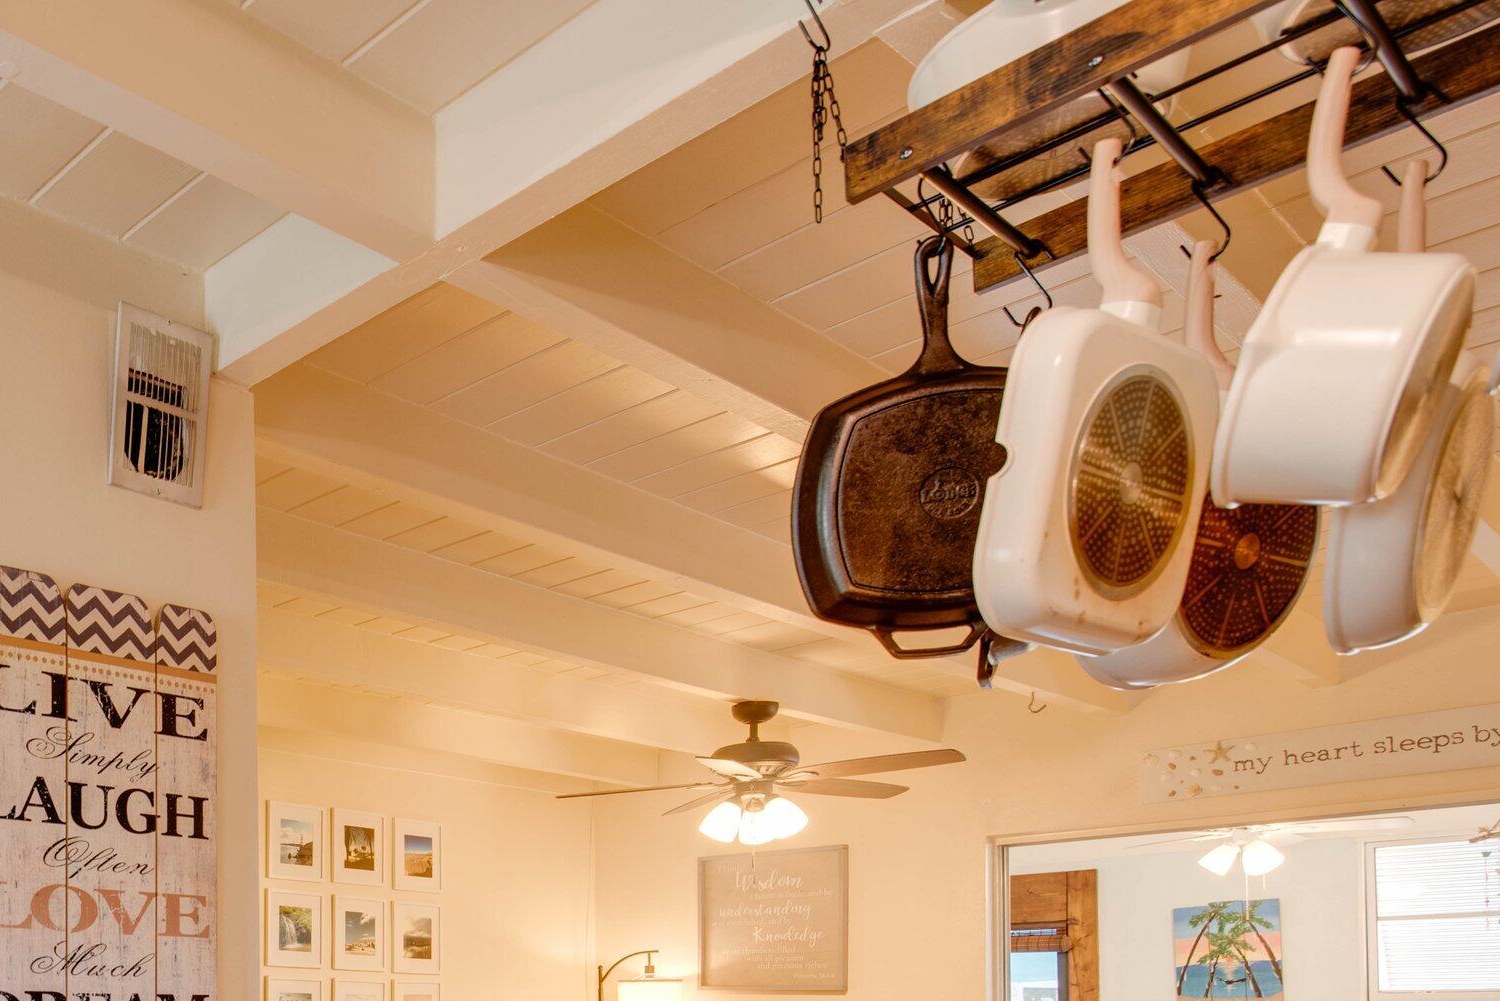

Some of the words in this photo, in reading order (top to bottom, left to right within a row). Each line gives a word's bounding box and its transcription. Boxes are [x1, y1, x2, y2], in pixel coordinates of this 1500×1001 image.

[26, 726, 160, 783] Simply
[1234, 753, 1274, 775] my
[1284, 741, 1364, 767] heart
[1374, 731, 1465, 754] sleeps
[43, 836, 155, 879] Often
[752, 926, 824, 948] Knowledge
[30, 941, 155, 978] Much
